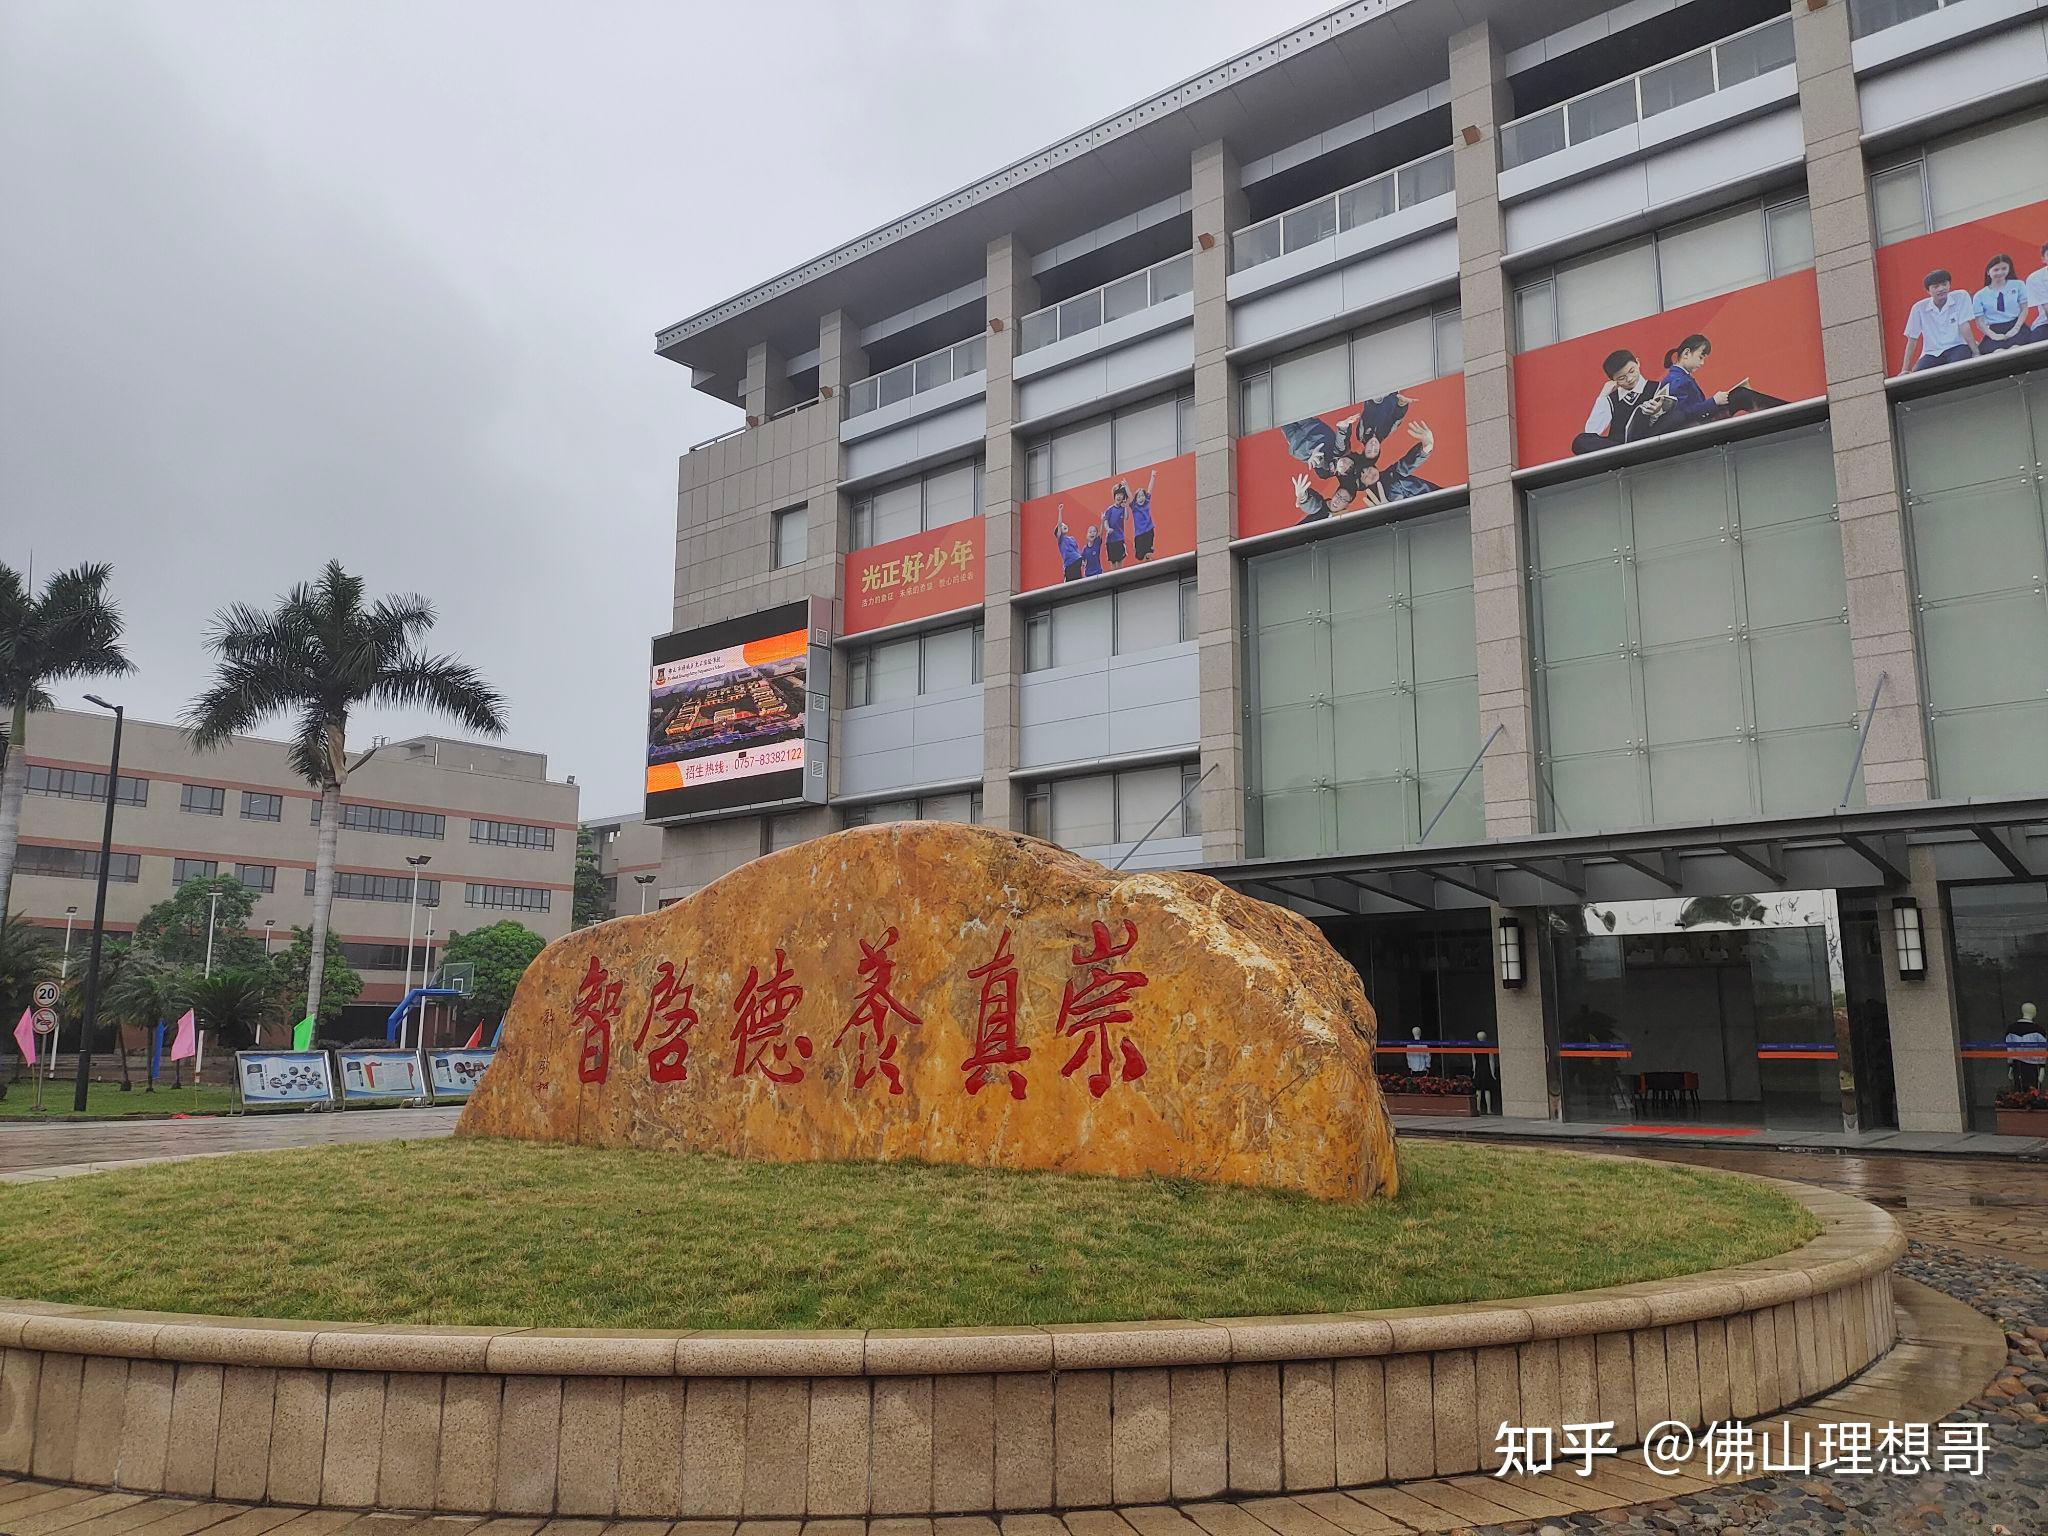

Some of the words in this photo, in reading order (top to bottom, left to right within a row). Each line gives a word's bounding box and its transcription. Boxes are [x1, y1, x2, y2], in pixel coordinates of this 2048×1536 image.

[861, 540, 975, 593] 光正好少年
[39, 988, 55, 999] 20
